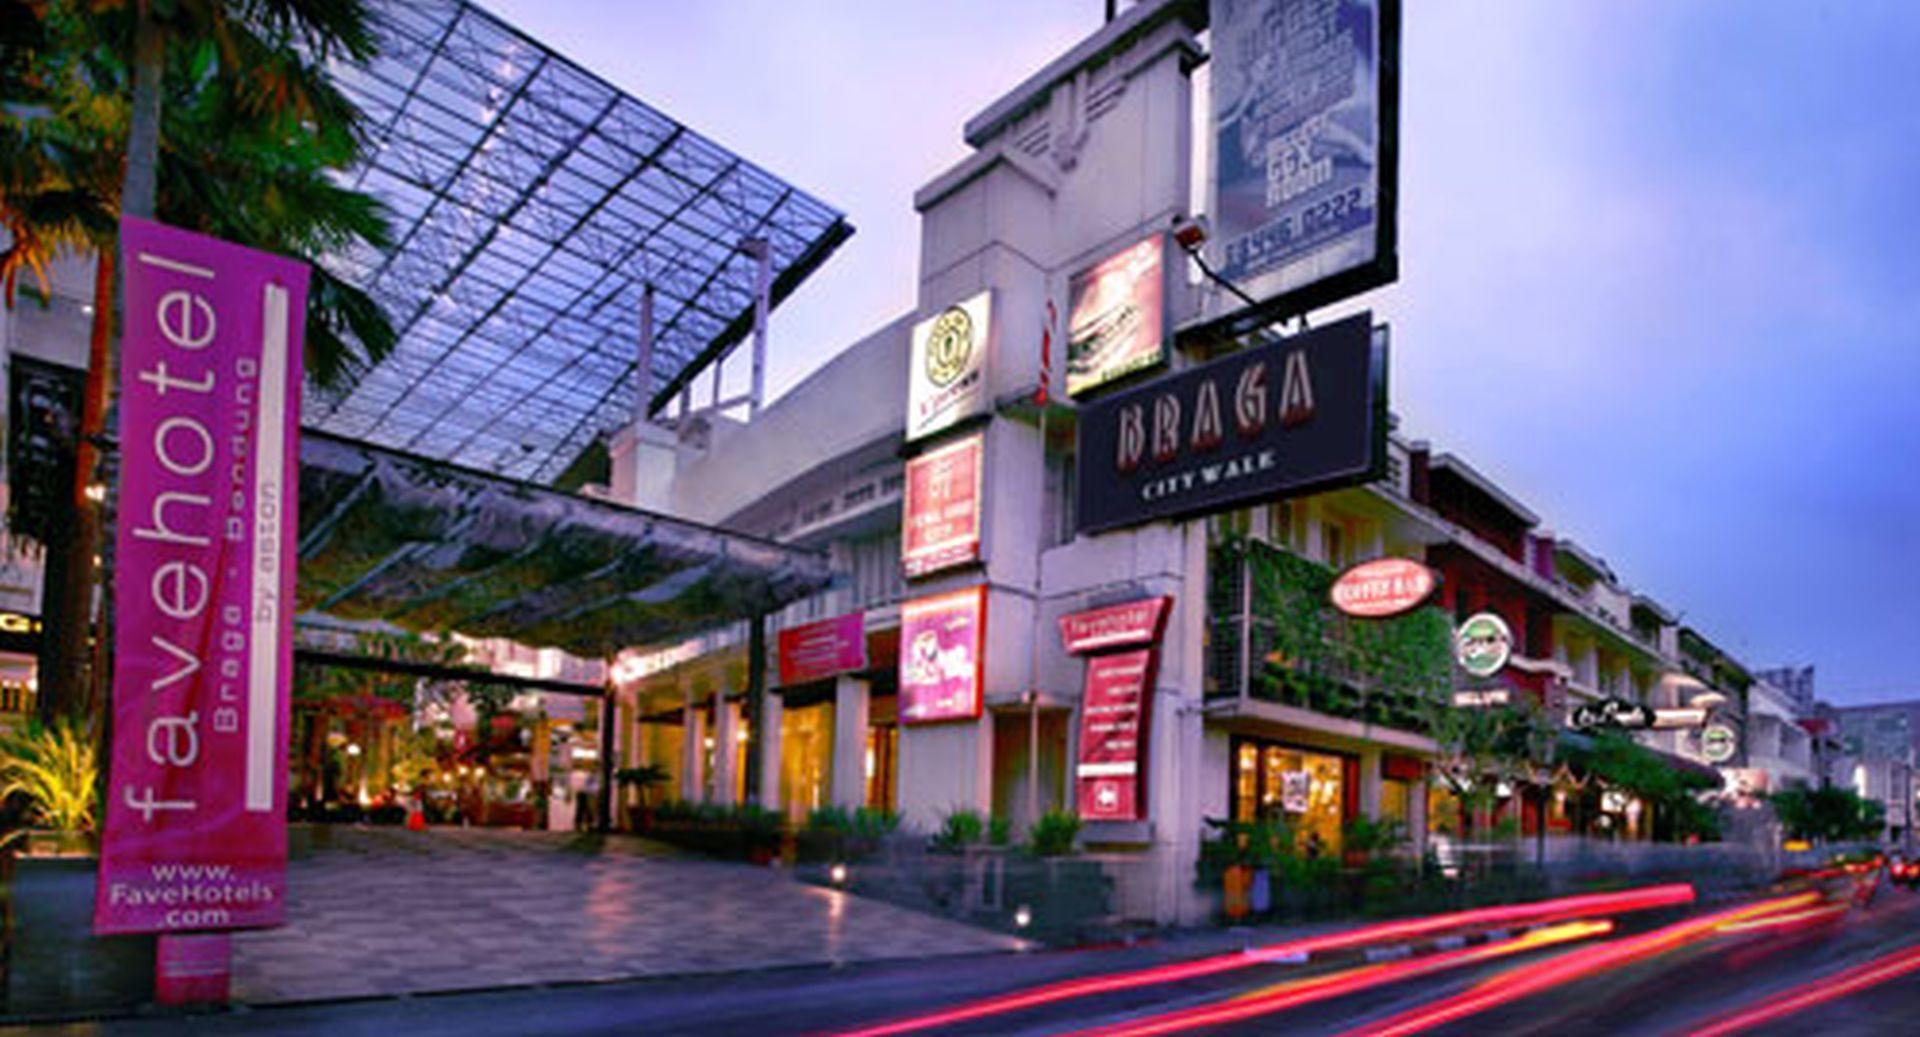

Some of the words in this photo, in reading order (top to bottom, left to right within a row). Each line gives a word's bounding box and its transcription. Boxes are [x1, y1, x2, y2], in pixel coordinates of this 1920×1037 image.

[226, 356, 258, 541] Bandung
[1118, 350, 1315, 470] BRAGA
[1142, 472, 1197, 501] CITY
[1200, 450, 1276, 484] WALK
[123, 252, 217, 822] favehotel
[213, 605, 245, 733] Braga
[108, 880, 274, 905] FaveHotels
[151, 865, 236, 882] www.
[156, 907, 231, 928] .com
